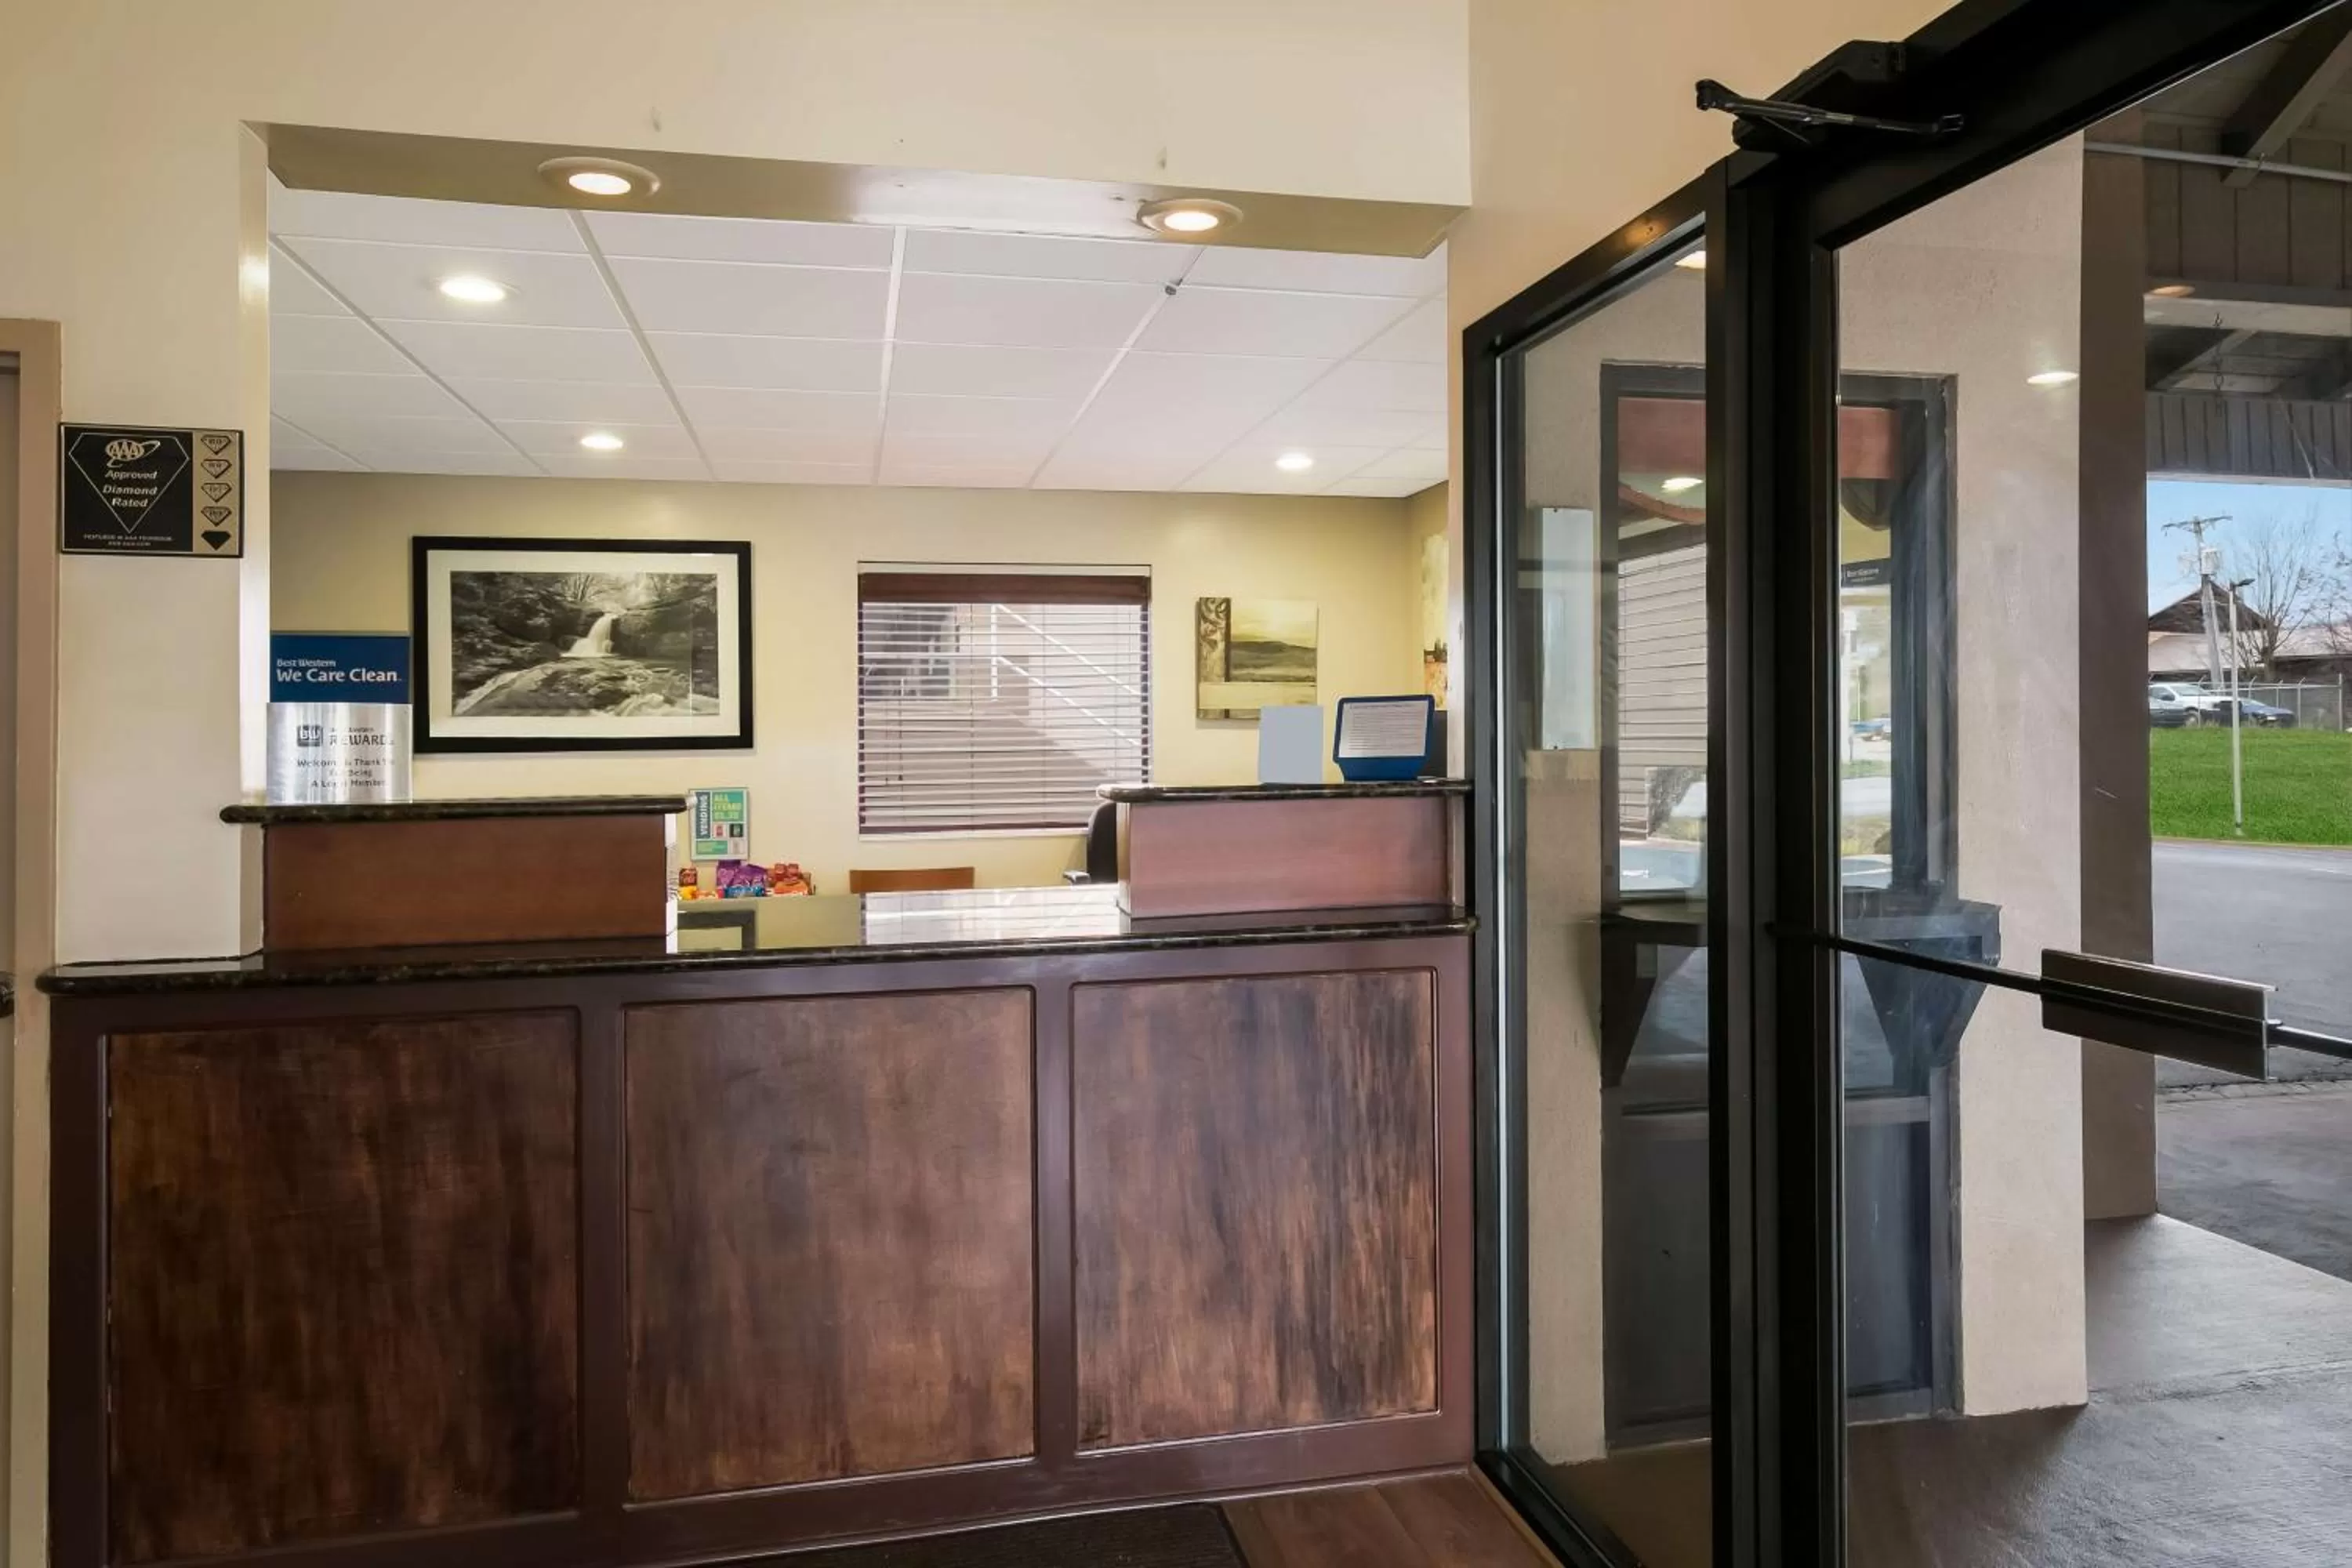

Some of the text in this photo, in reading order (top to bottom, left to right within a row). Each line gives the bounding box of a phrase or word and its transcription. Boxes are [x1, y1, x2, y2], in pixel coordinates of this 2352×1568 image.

[106, 441, 143, 459] AAA
[105, 470, 158, 480] Approved
[103, 484, 158, 495] Diamond
[111, 498, 149, 508] Rated
[277, 659, 336, 667] Best Western
[276, 668, 303, 683] We
[306, 668, 346, 683] Care
